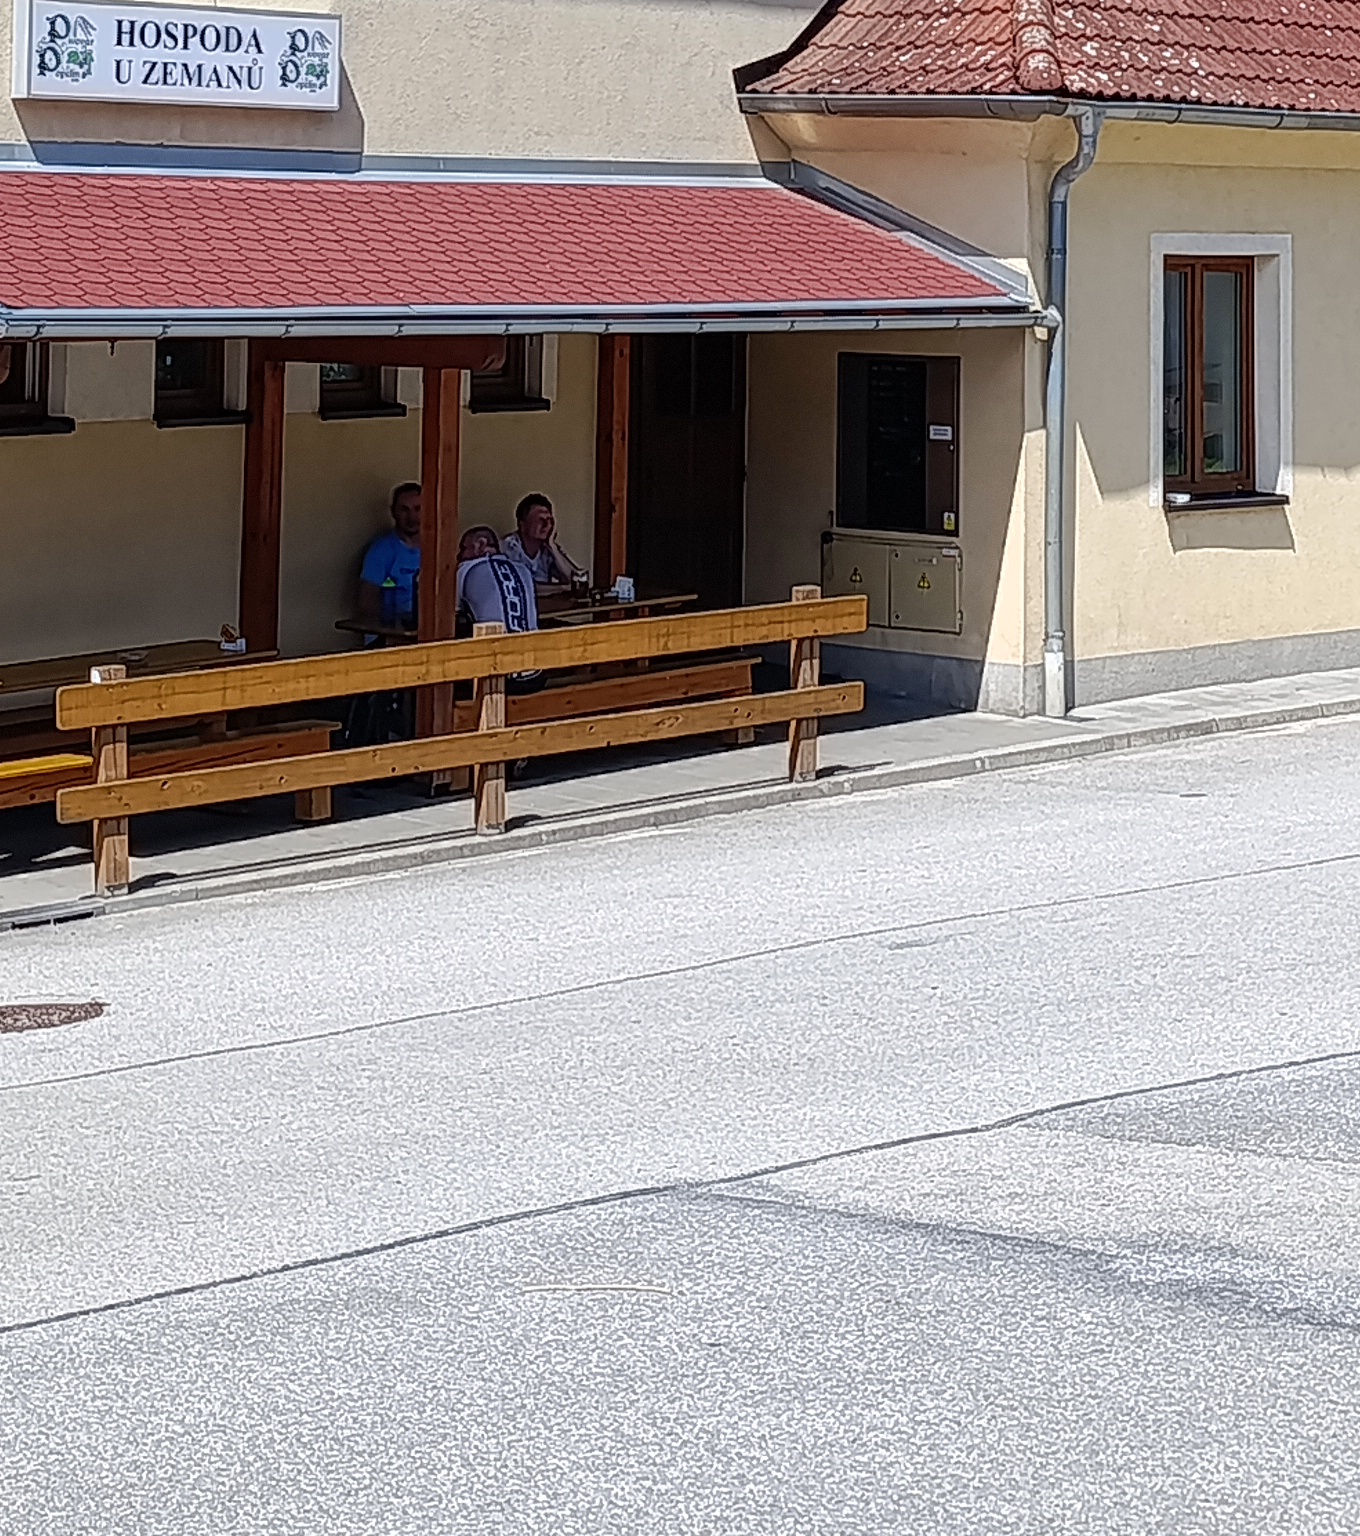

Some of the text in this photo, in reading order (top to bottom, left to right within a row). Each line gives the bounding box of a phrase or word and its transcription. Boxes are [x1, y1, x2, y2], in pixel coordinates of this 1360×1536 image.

[114, 19, 264, 55] HOSPODA
[114, 58, 133, 84] U
[141, 58, 264, 91] ZEMANŮ
[493, 561, 523, 632] FORCE
